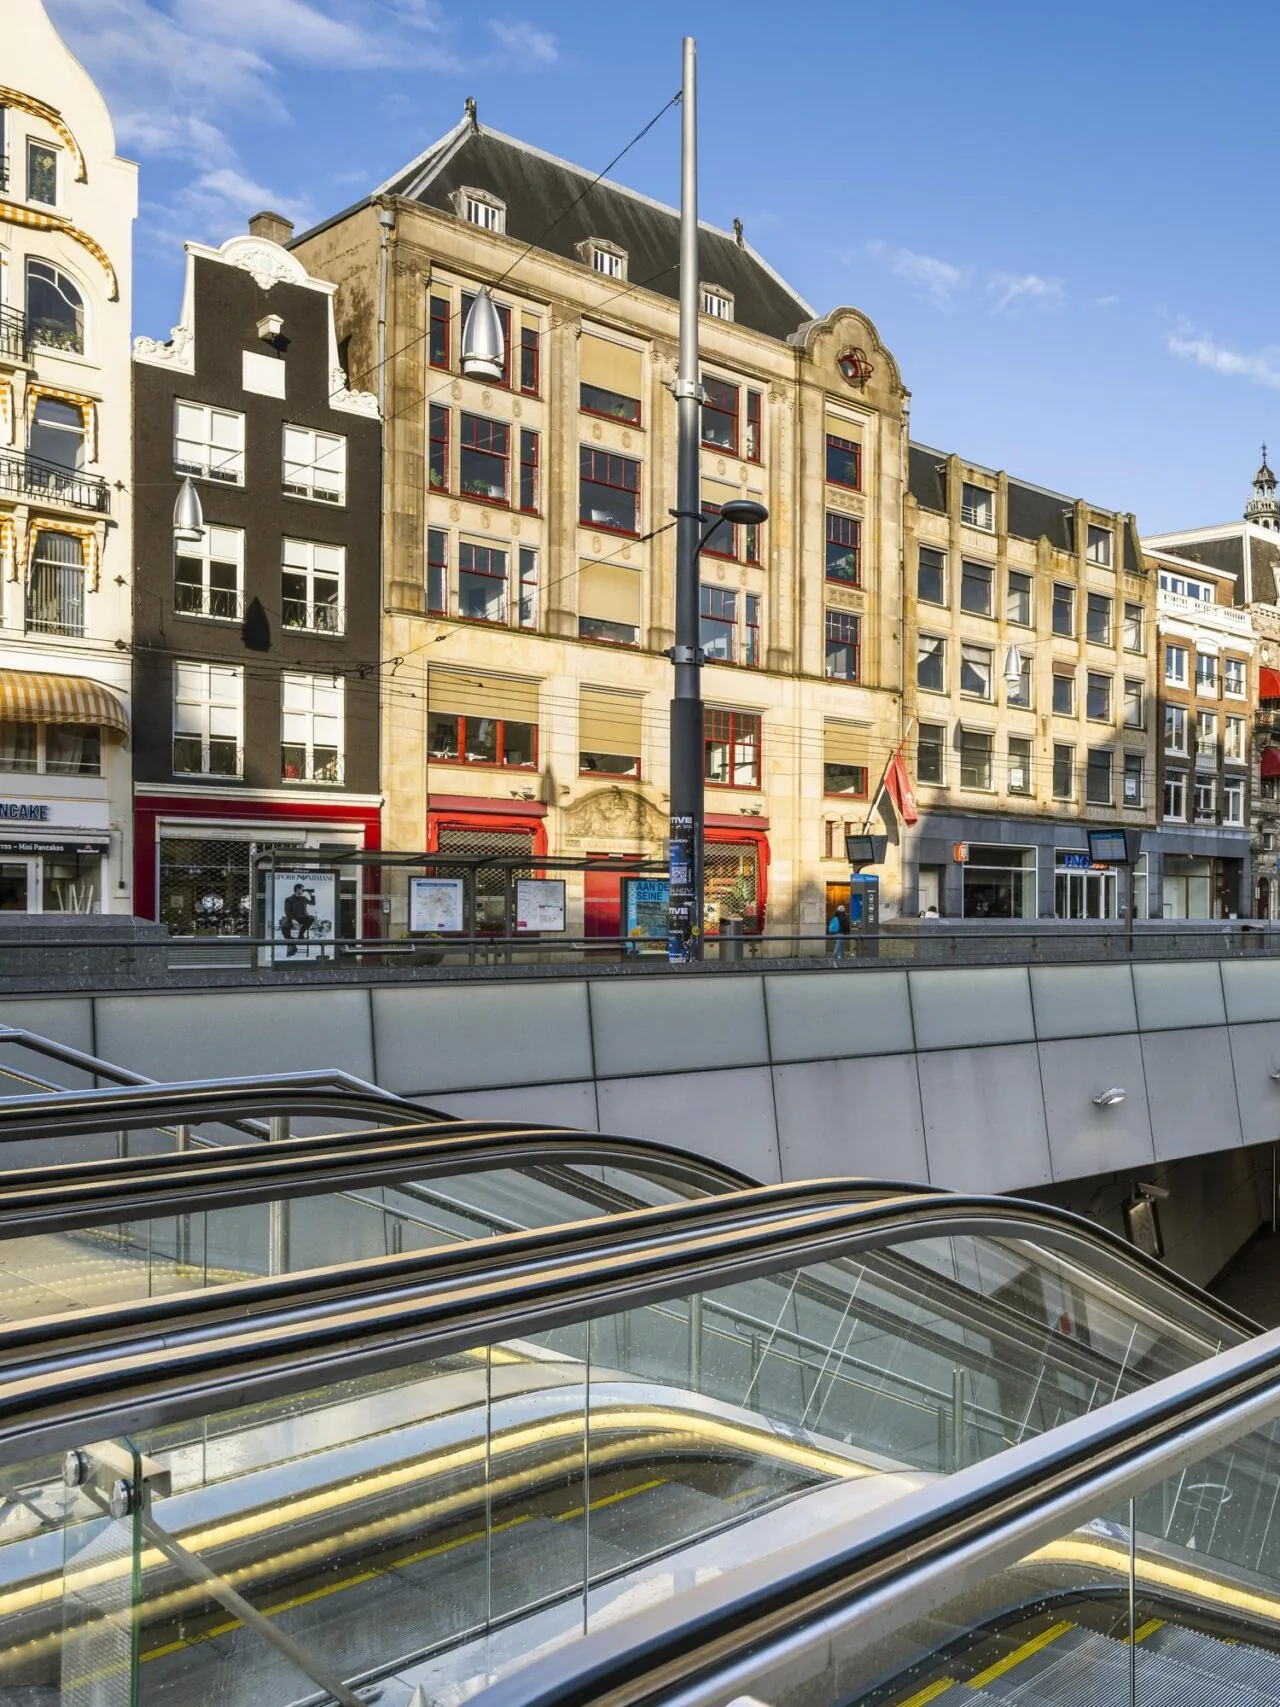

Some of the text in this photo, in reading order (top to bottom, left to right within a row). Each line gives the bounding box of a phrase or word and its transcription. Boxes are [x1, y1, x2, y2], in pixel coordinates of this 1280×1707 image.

[34, 844, 64, 852] Pancakes
[1064, 854, 1090, 868] ING
[306, 873, 333, 882] ARMANI
[637, 882, 655, 891] AAN
[658, 882, 669, 891] DE
[637, 892, 662, 900] SEINE
